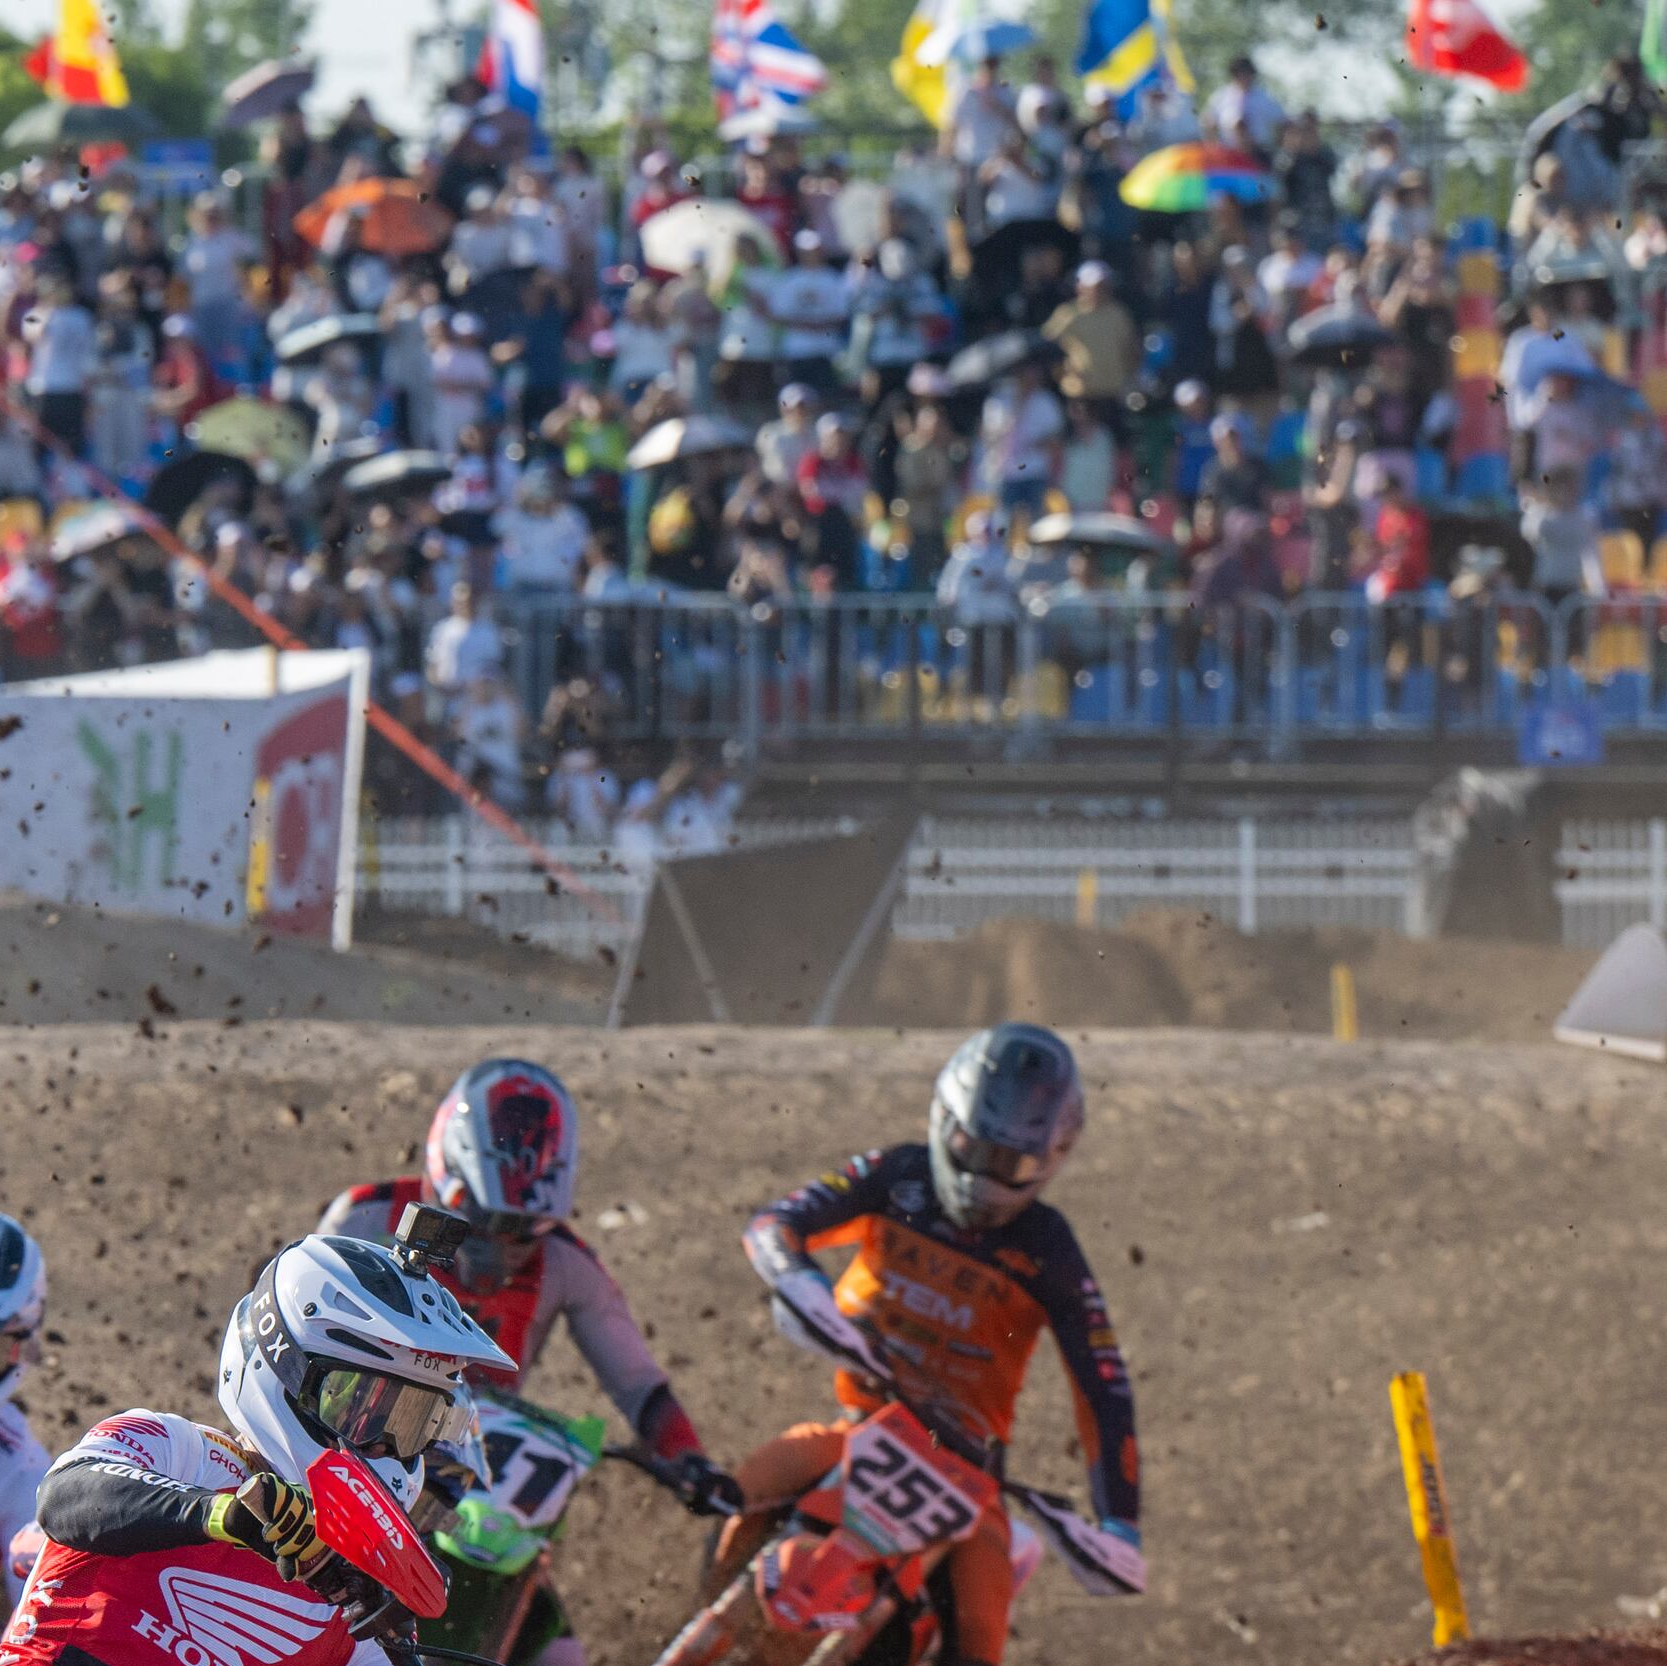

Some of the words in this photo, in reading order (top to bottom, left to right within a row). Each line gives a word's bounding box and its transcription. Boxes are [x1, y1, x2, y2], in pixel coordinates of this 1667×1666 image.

[253, 1292, 291, 1364] FOX
[413, 1353, 442, 1373] FOX
[90, 1461, 197, 1494] HONDA
[326, 1464, 406, 1554] ACERBIS
[849, 1437, 973, 1546] 253
